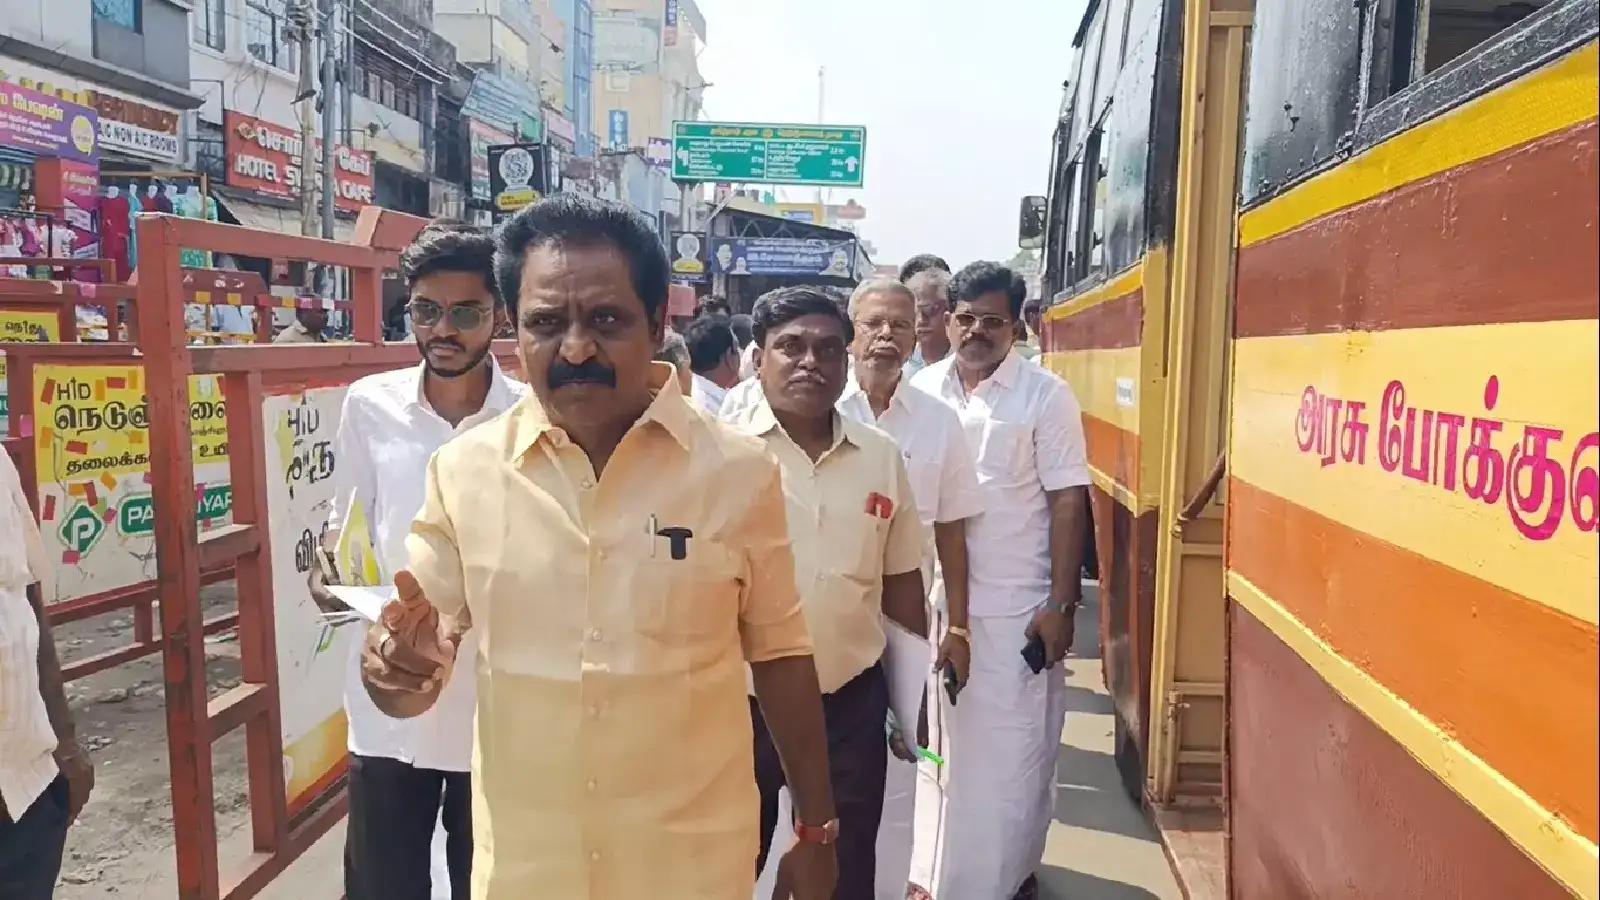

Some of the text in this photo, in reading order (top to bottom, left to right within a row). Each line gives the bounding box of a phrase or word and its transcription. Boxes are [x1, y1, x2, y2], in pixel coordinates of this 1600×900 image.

[114, 126, 132, 143] NON
[149, 134, 177, 155] ROOMS
[235, 153, 281, 183] HOTEL
[341, 180, 373, 205] CAFE
[1295, 385, 1370, 468] அரசு
